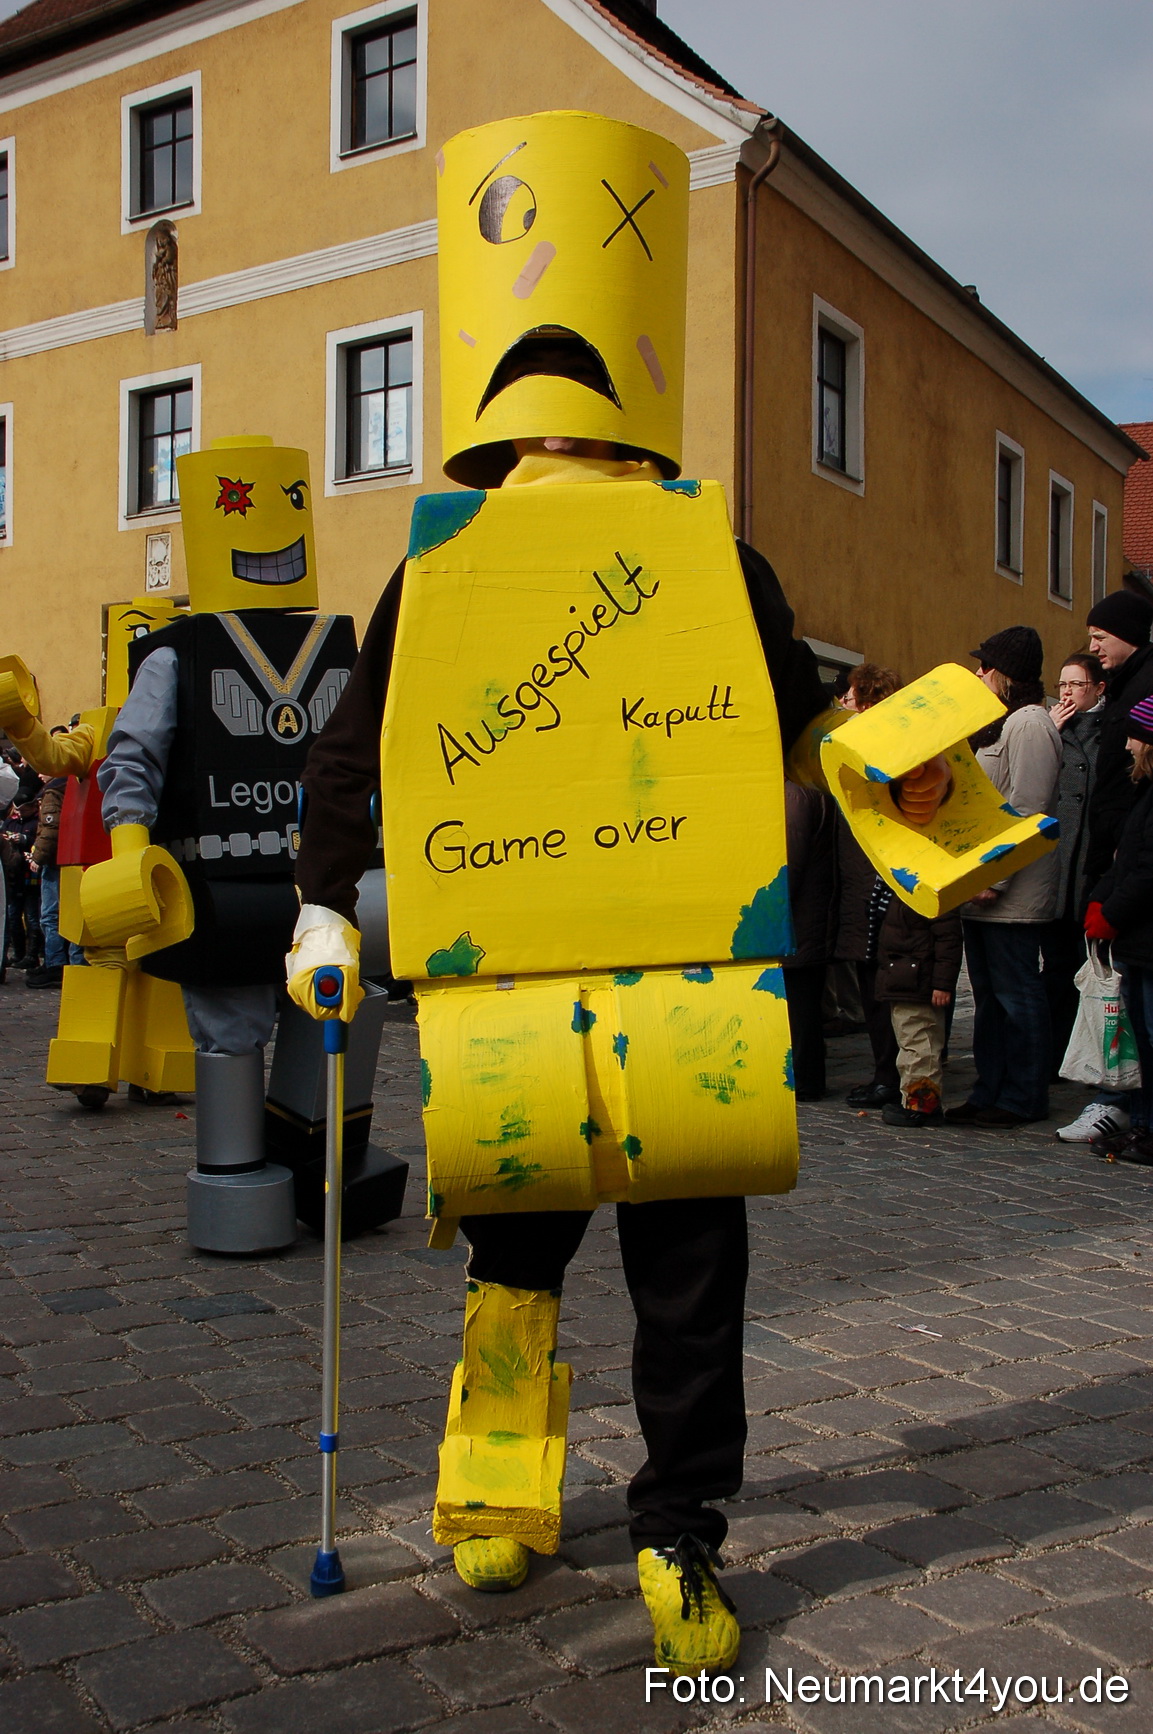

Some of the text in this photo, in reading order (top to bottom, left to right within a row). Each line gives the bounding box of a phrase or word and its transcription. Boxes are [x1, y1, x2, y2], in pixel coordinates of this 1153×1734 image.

[437, 551, 660, 785] Ausgespielt
[277, 706, 298, 734] A
[621, 685, 740, 738] Kaputt
[424, 813, 688, 873] Game over
